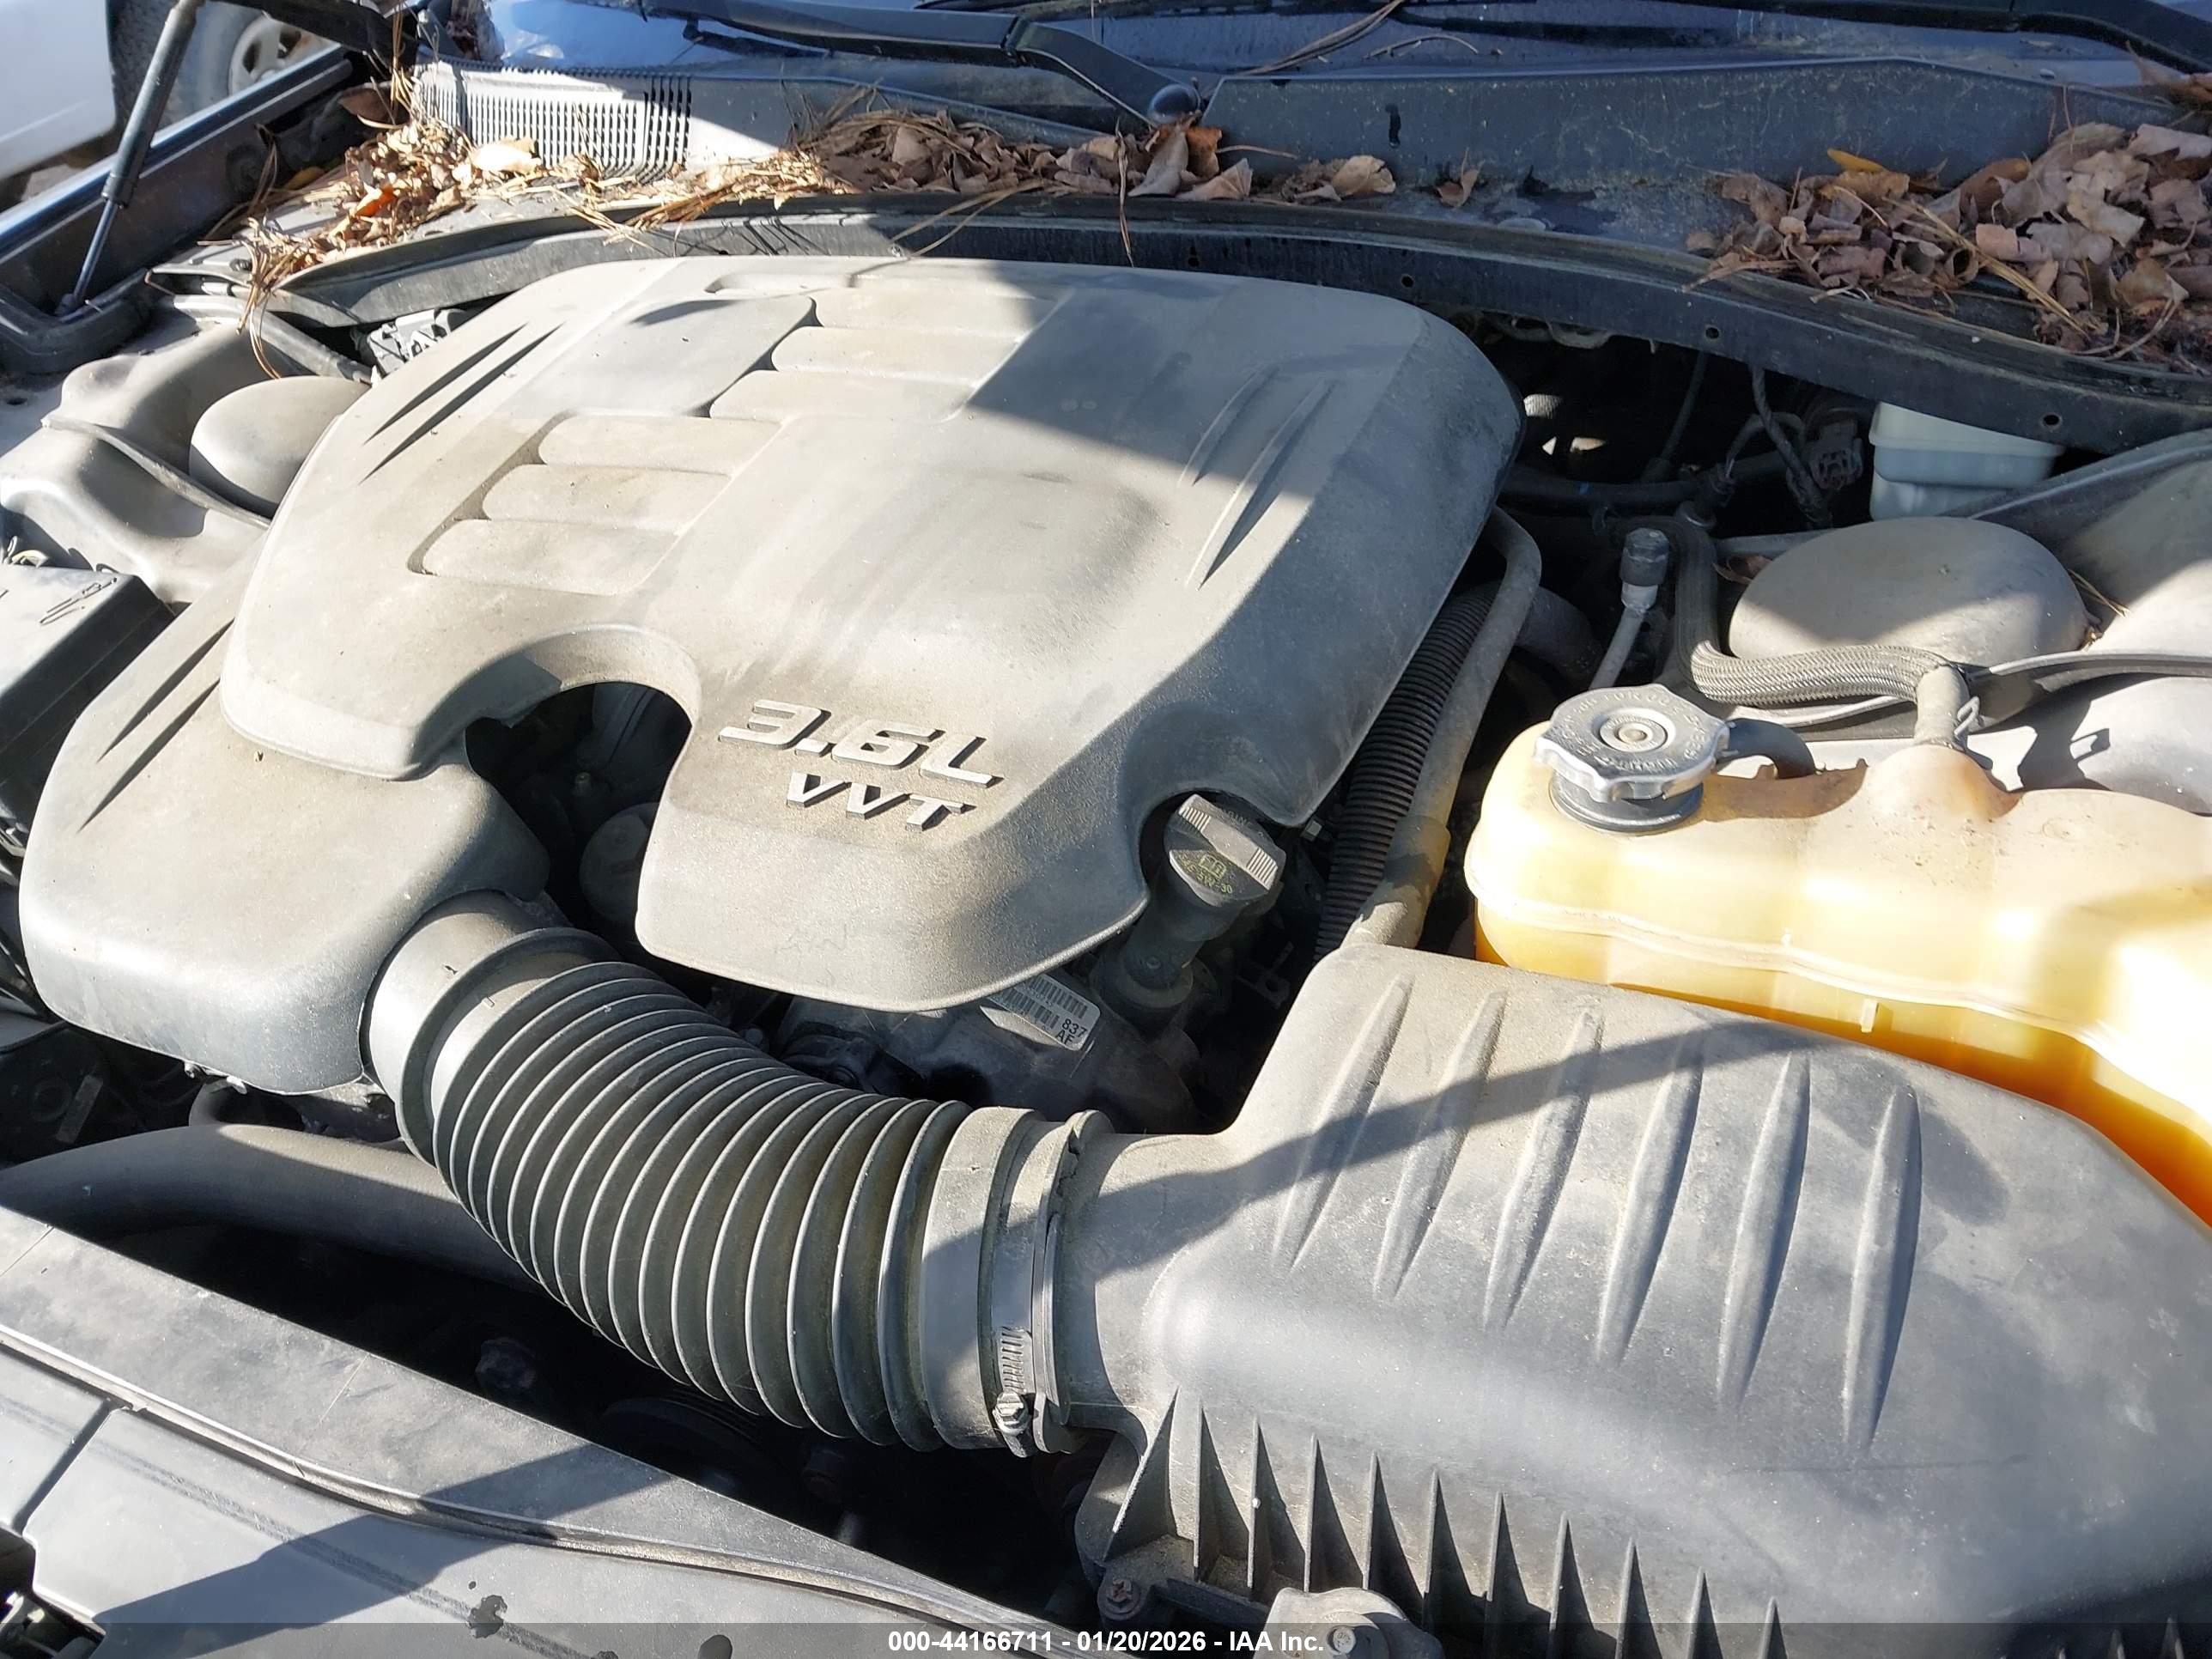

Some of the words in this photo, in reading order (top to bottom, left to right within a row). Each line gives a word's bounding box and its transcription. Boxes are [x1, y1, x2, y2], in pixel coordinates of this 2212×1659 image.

[718, 699, 995, 788] 3.6L
[786, 772, 969, 832] VVT
[1054, 1030, 1075, 1046] AF
[1061, 1018, 1087, 1037] 837
